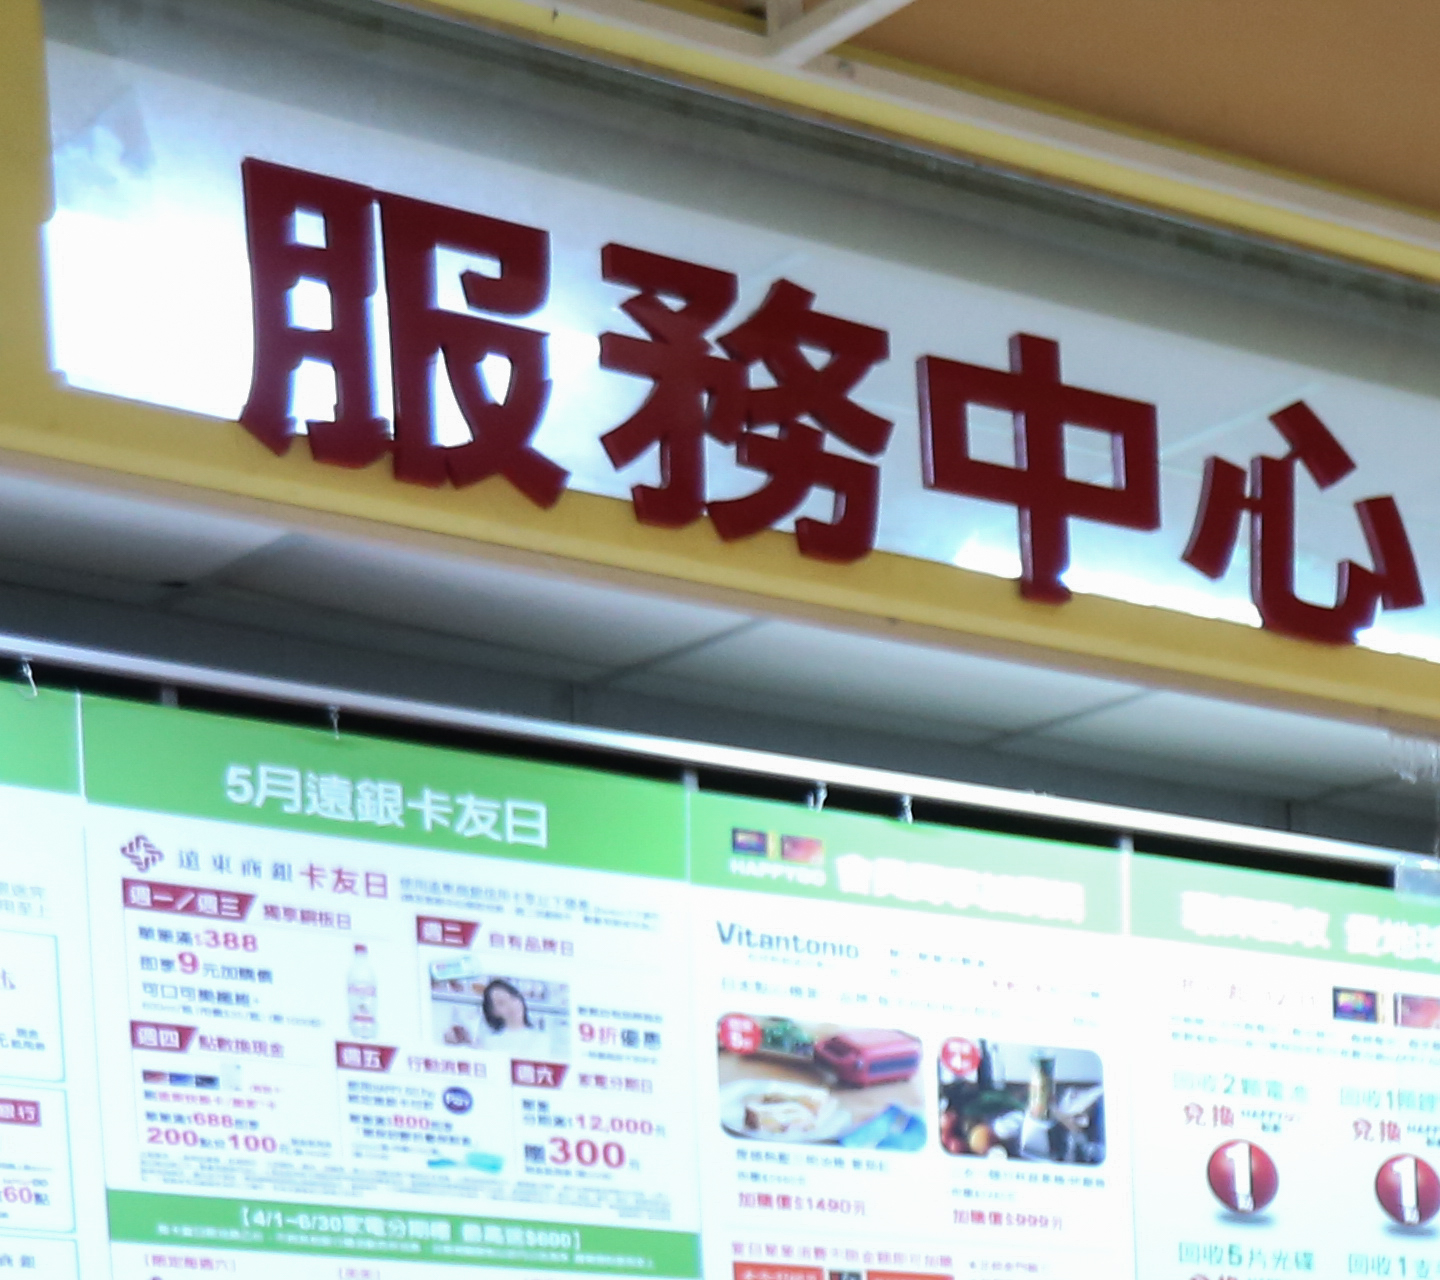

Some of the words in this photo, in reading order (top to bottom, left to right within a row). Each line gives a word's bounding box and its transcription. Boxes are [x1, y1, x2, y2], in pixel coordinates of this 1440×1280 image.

[239, 157, 1420, 645] 服務中心
[226, 764, 549, 849] 5月遠銀卡友日
[715, 919, 860, 960] Vitantonio
